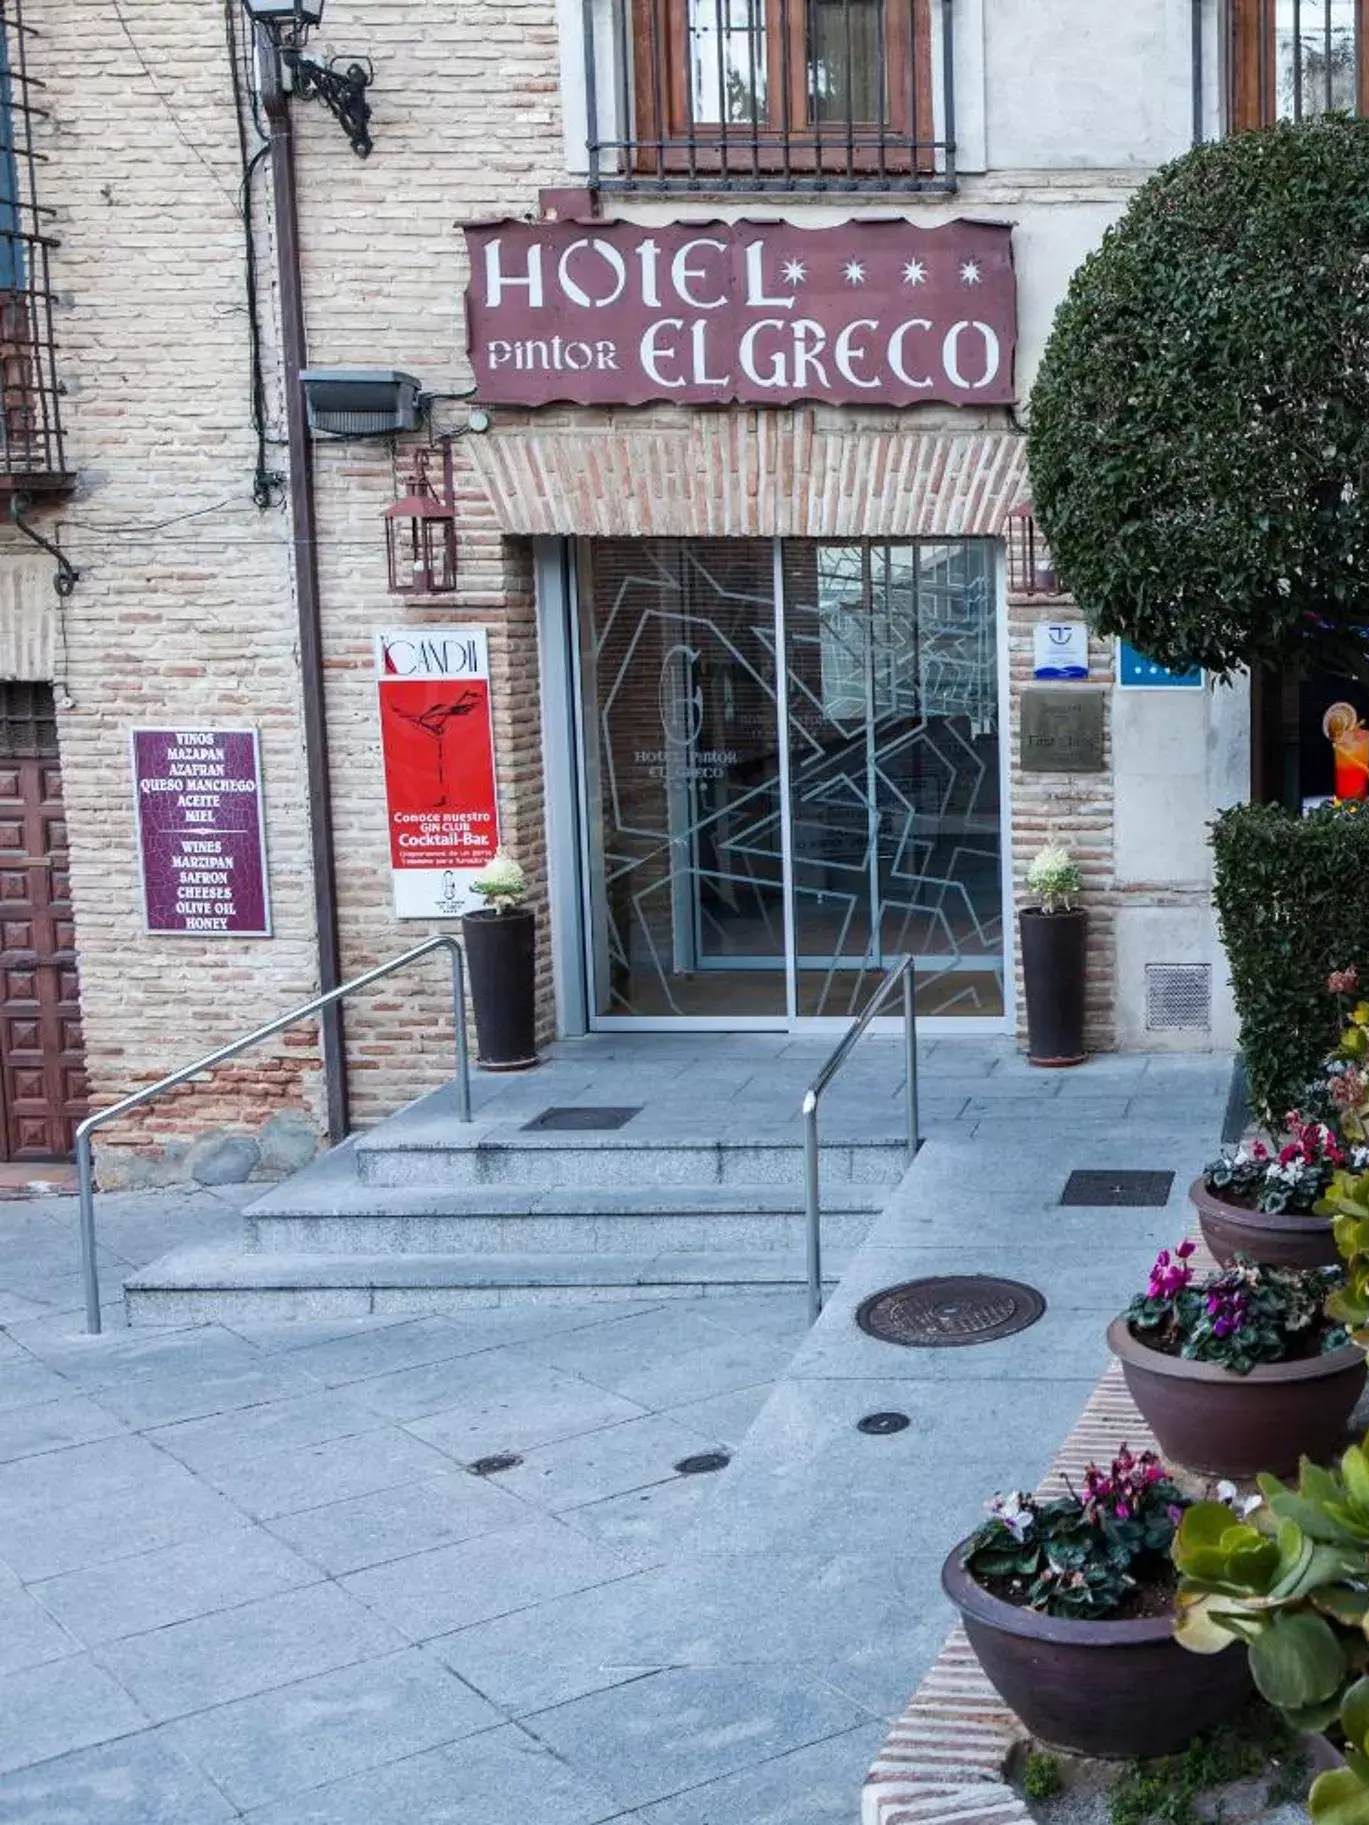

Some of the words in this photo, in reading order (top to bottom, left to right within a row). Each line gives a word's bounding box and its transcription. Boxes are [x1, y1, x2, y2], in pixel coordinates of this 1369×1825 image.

[640, 318, 730, 389] EL
[738, 318, 1000, 390] GRECO
[176, 733, 214, 745] VINOS
[167, 748, 224, 760] MAZAPAN
[169, 764, 224, 776] AZAFRAN
[140, 779, 183, 793] QUESO
[187, 779, 255, 791] MANCHEGO
[176, 795, 220, 807] ACEITE
[185, 811, 215, 822] MIEL
[394, 812, 441, 823] Conoce
[443, 812, 490, 822] nuestro
[420, 823, 440, 832] GIN
[182, 841, 222, 853] WINES
[172, 856, 234, 868] MARZIPAN
[180, 872, 228, 883] SAFRON
[176, 887, 232, 899] CHEESES
[176, 903, 210, 915] OLIVE
[214, 903, 236, 915] OIL
[186, 917, 228, 929] HONEY
